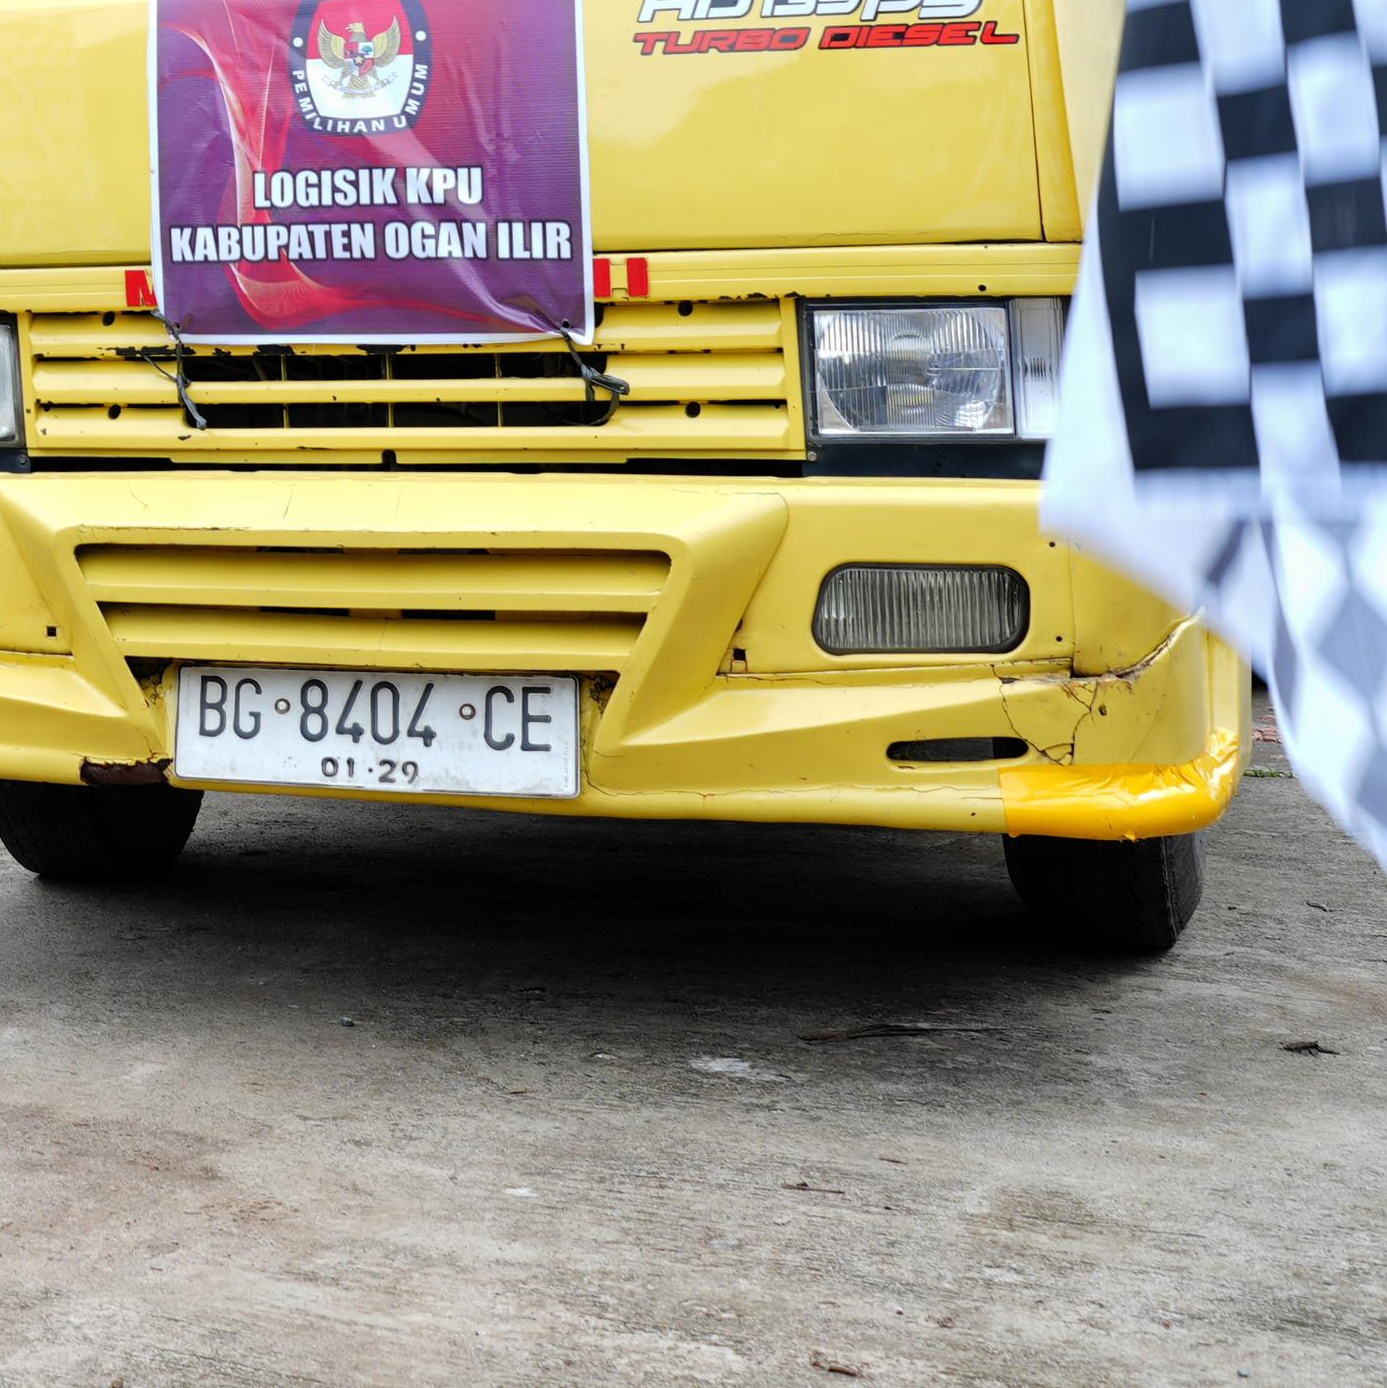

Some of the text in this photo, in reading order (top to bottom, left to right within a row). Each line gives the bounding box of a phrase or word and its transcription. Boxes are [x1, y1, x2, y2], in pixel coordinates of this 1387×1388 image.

[633, 21, 1020, 55] TURBO DIESEL
[292, 64, 429, 134] PEMILIHAN UMUM
[253, 167, 483, 208] LOGISIK KPU
[170, 220, 572, 261] KABUPATEN OGAN ILIR
[199, 675, 552, 752] BG 8404 CE
